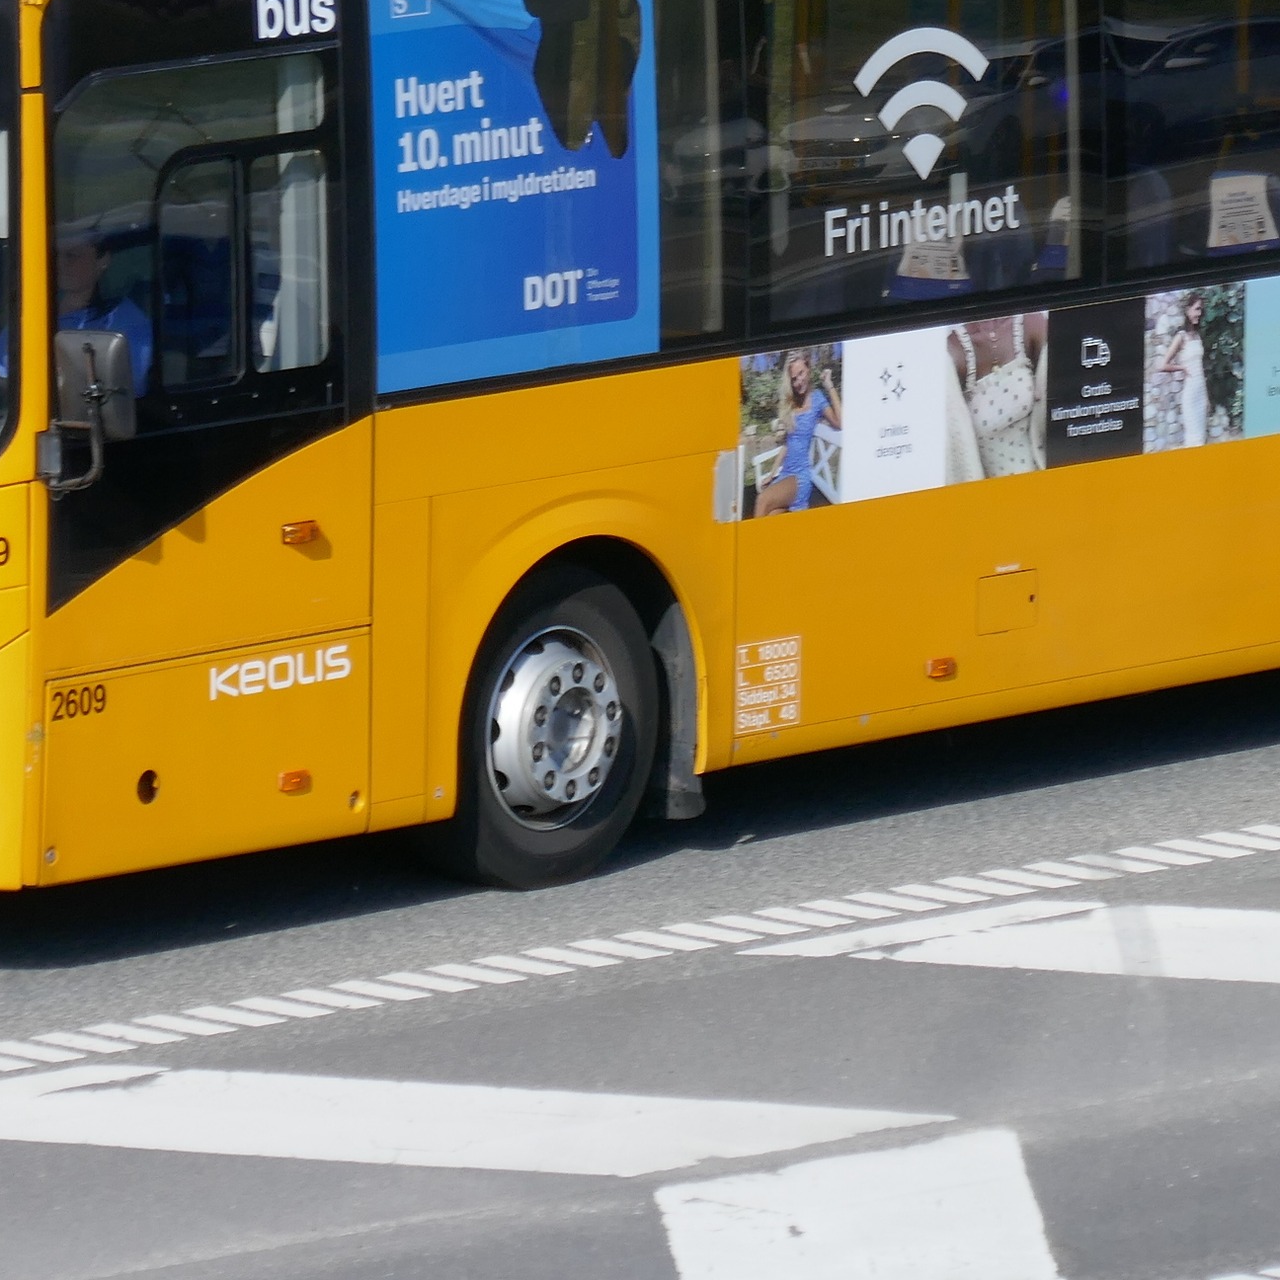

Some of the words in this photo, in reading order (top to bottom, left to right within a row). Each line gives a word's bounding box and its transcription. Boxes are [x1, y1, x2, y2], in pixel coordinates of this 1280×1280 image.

[394, 70, 485, 118] Hvert
[397, 128, 449, 173] 10.
[452, 117, 544, 166] minut
[397, 183, 481, 214] Hverdage
[482, 176, 490, 201] i
[491, 167, 597, 203] myldretiden
[824, 204, 871, 257] Fri
[878, 185, 1020, 249] internet
[523, 269, 583, 311] DOT
[51, 683, 107, 723] 2609
